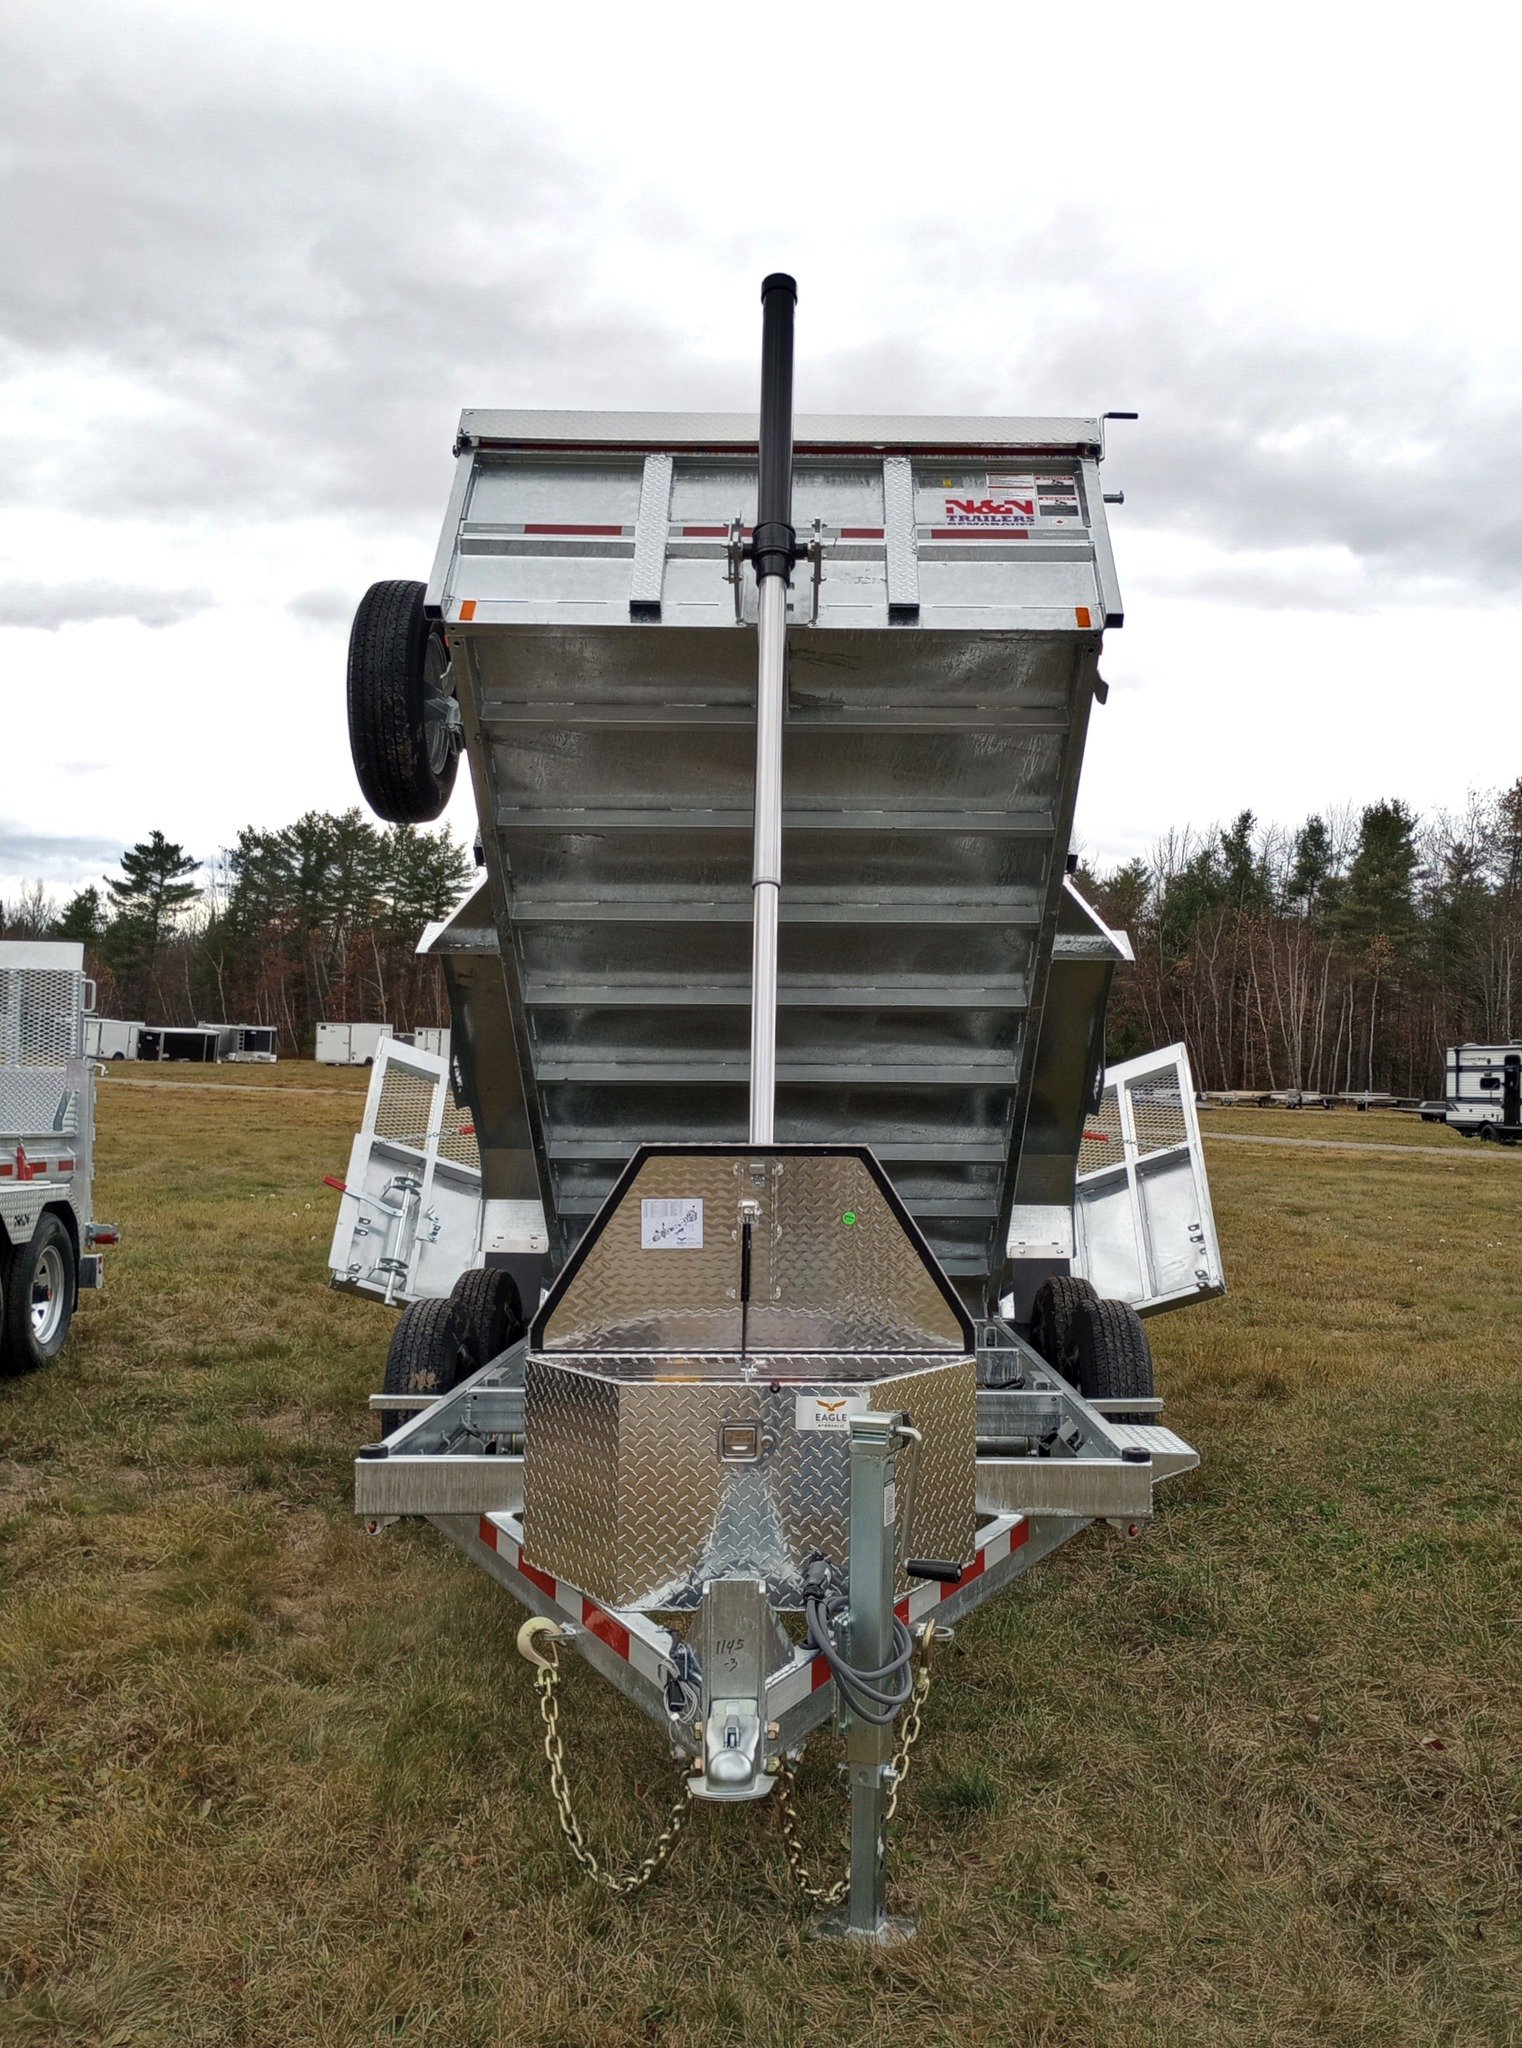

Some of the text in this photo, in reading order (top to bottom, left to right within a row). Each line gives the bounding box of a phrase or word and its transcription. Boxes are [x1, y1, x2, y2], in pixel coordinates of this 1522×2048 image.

[946, 499, 1034, 514] N&N
[815, 1413, 847, 1421] EAGLE
[716, 1639, 745, 1655] 1145
